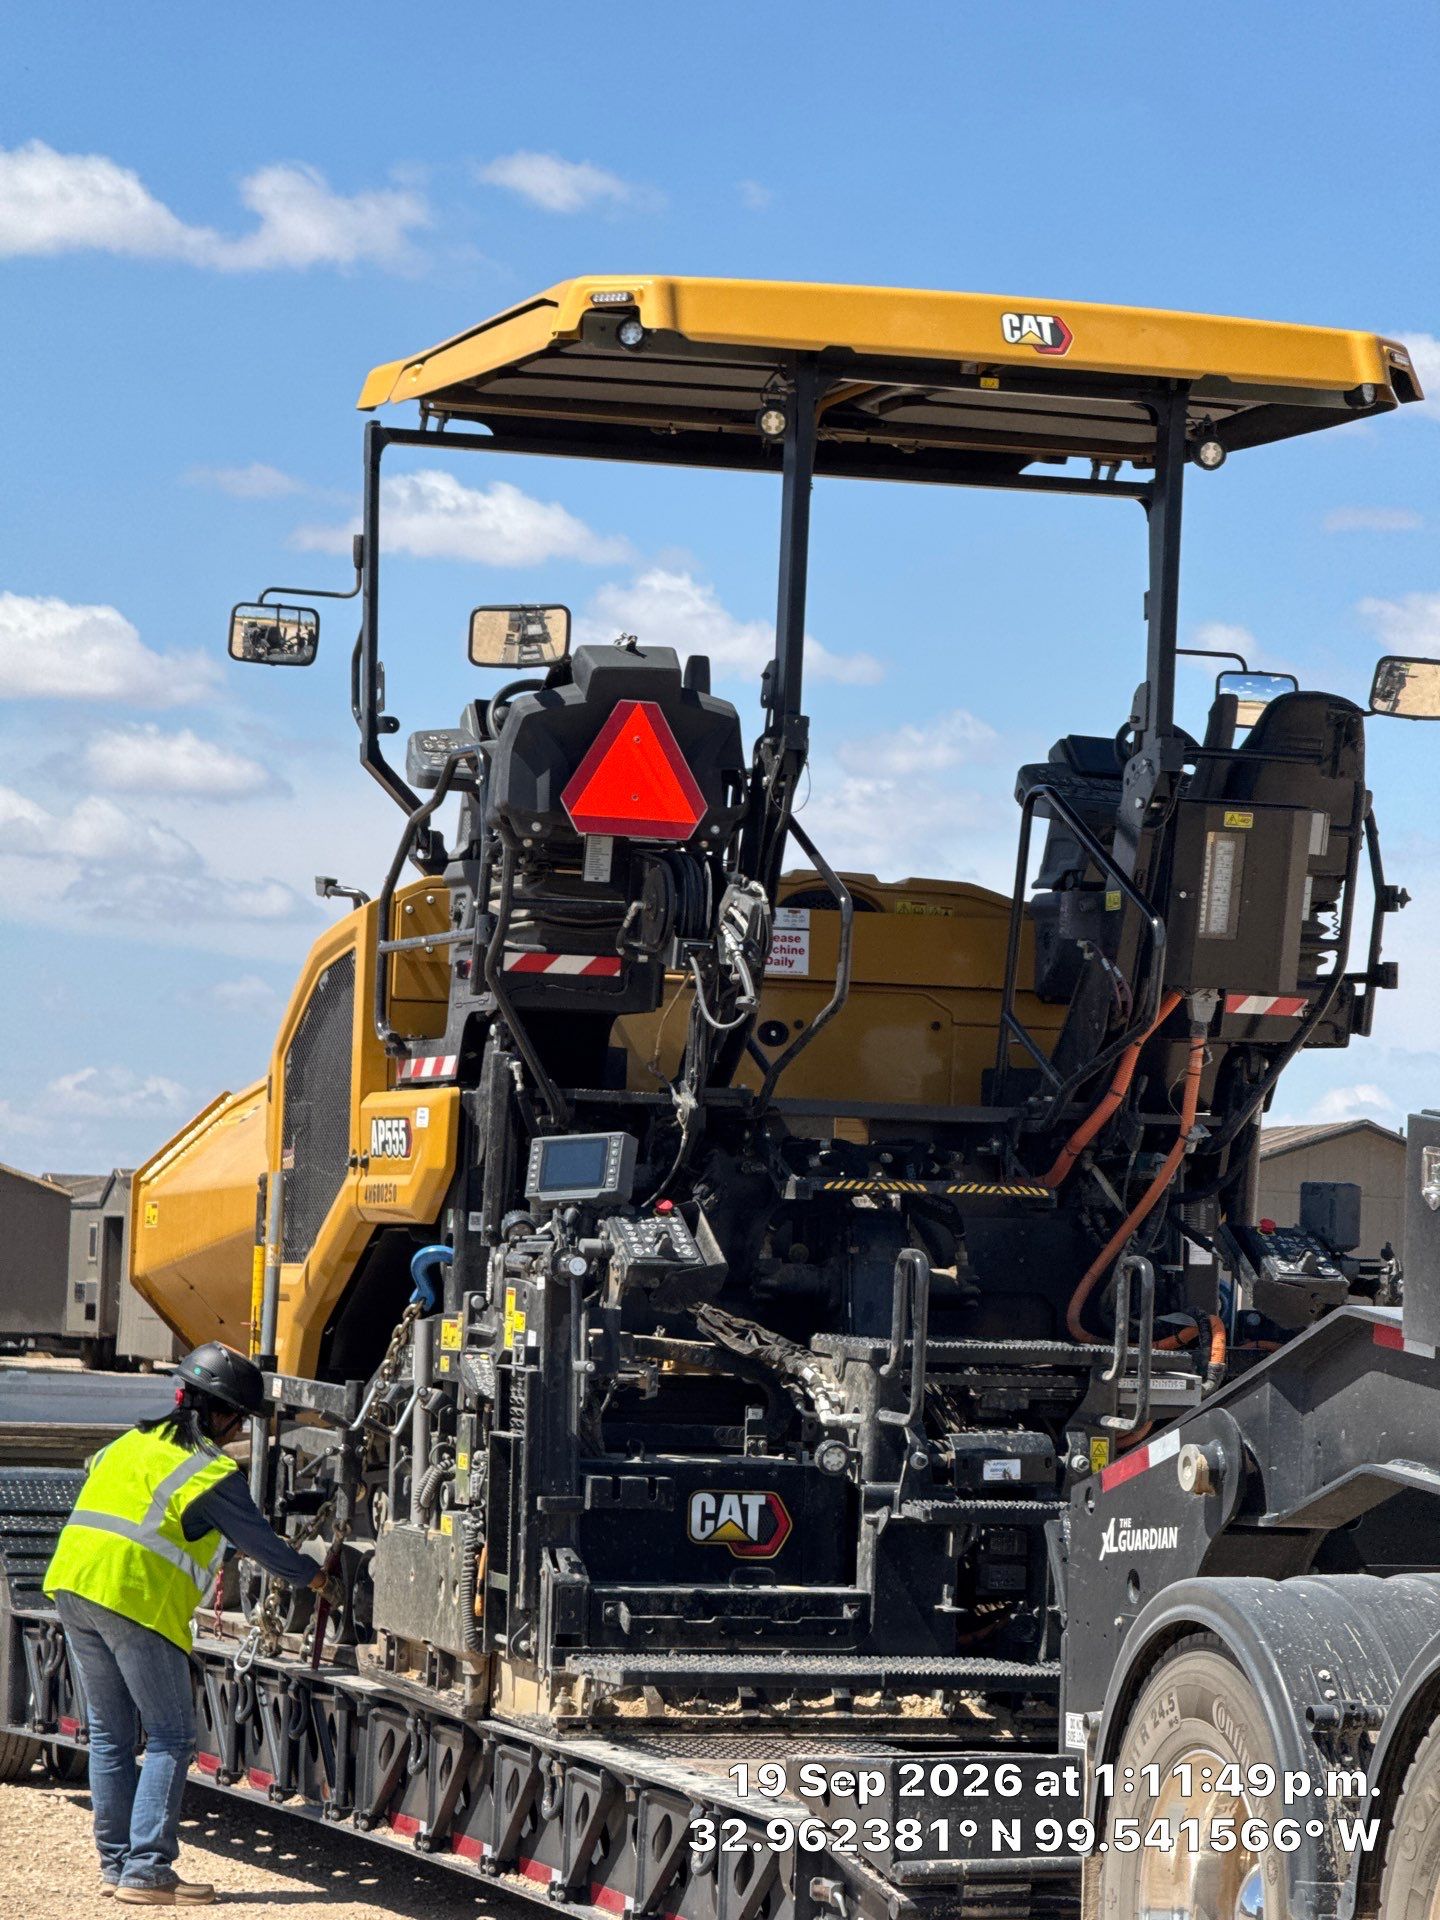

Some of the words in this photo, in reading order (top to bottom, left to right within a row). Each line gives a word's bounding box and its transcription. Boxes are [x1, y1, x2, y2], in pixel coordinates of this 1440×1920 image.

[1001, 313, 1054, 346] CAT
[772, 934, 802, 943] ease
[772, 945, 805, 955] chine
[764, 957, 795, 968] Daily
[371, 1118, 407, 1157] AP555
[690, 1492, 766, 1541] CAT
[1119, 1518, 1132, 1528] THE
[1118, 1526, 1179, 1552] GUARDIAN
[1150, 1692, 1175, 1729] 24.5
